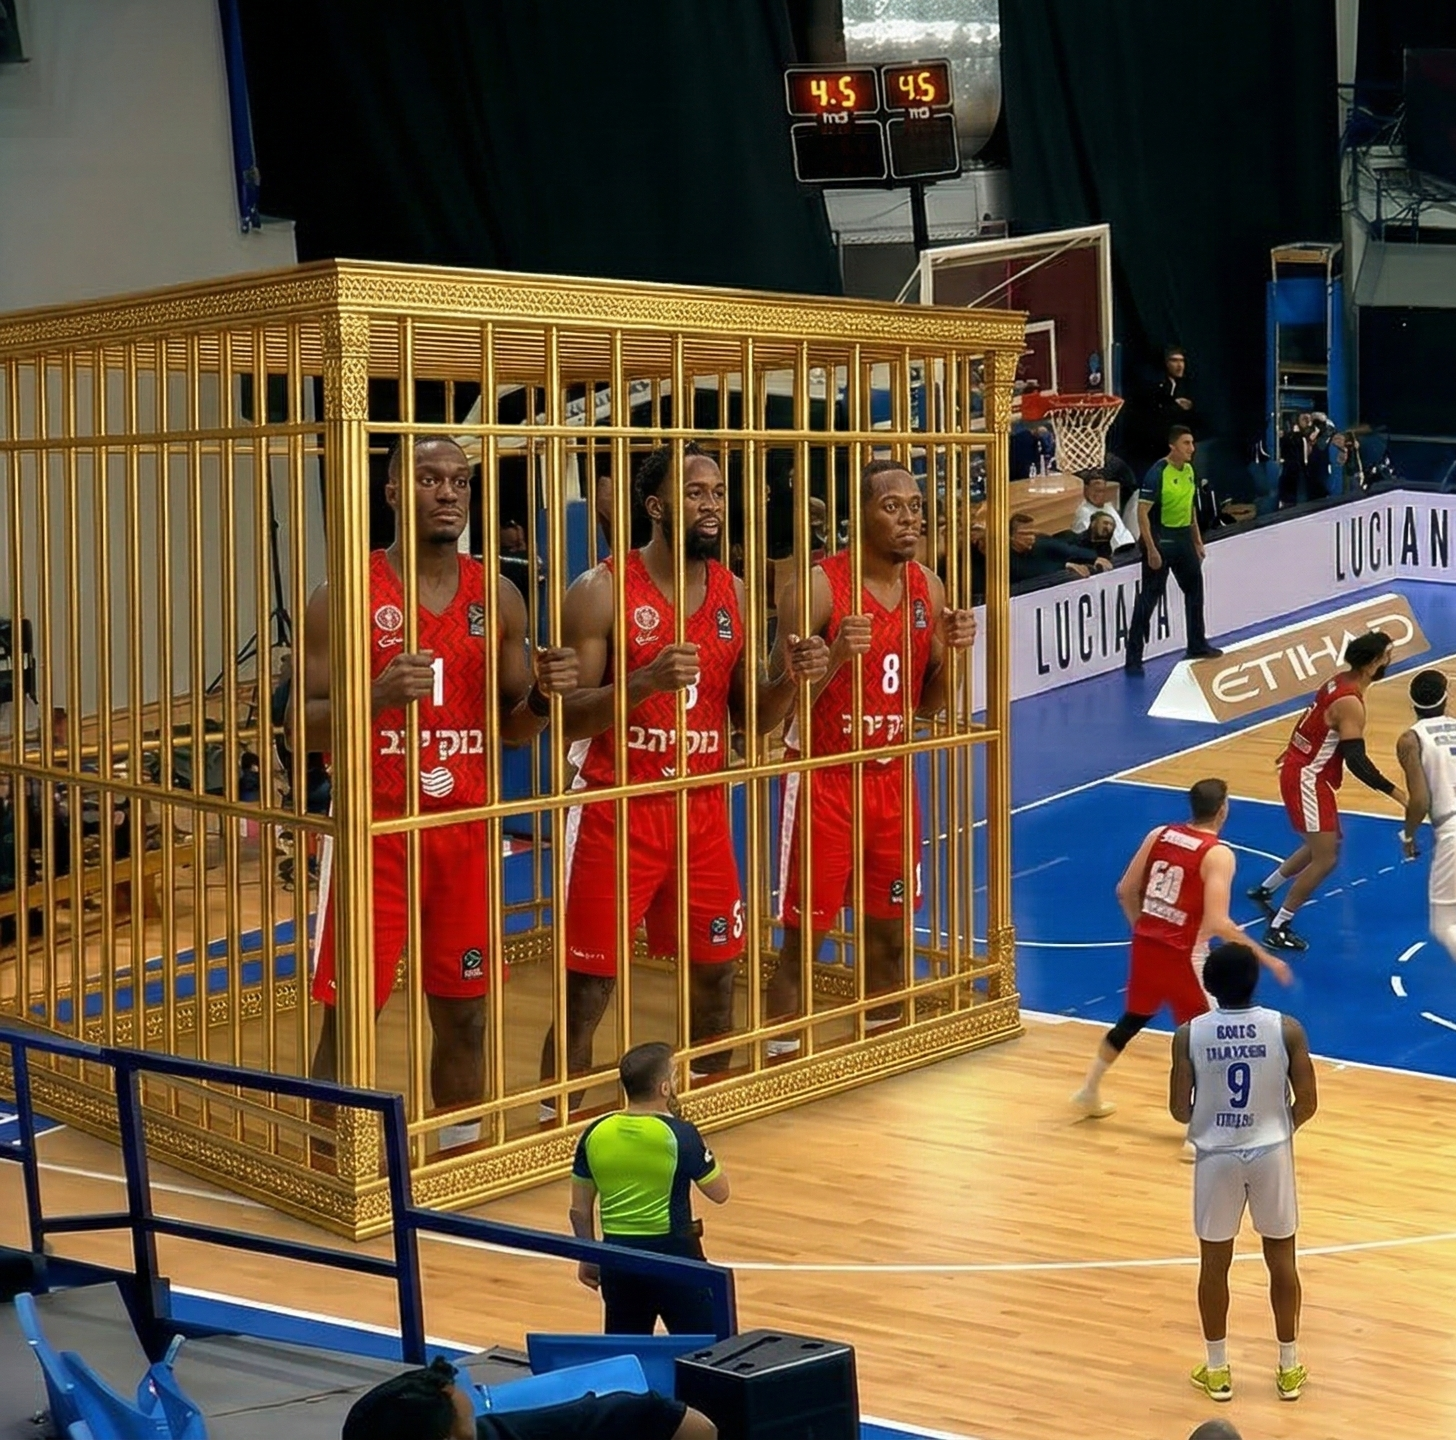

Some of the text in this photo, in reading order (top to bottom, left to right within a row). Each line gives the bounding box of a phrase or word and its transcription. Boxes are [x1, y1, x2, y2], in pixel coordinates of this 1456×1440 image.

[810, 76, 856, 107] 4.5
[899, 72, 935, 102] 4.5
[881, 653, 900, 695] 8
[1226, 1062, 1251, 1109] 9
